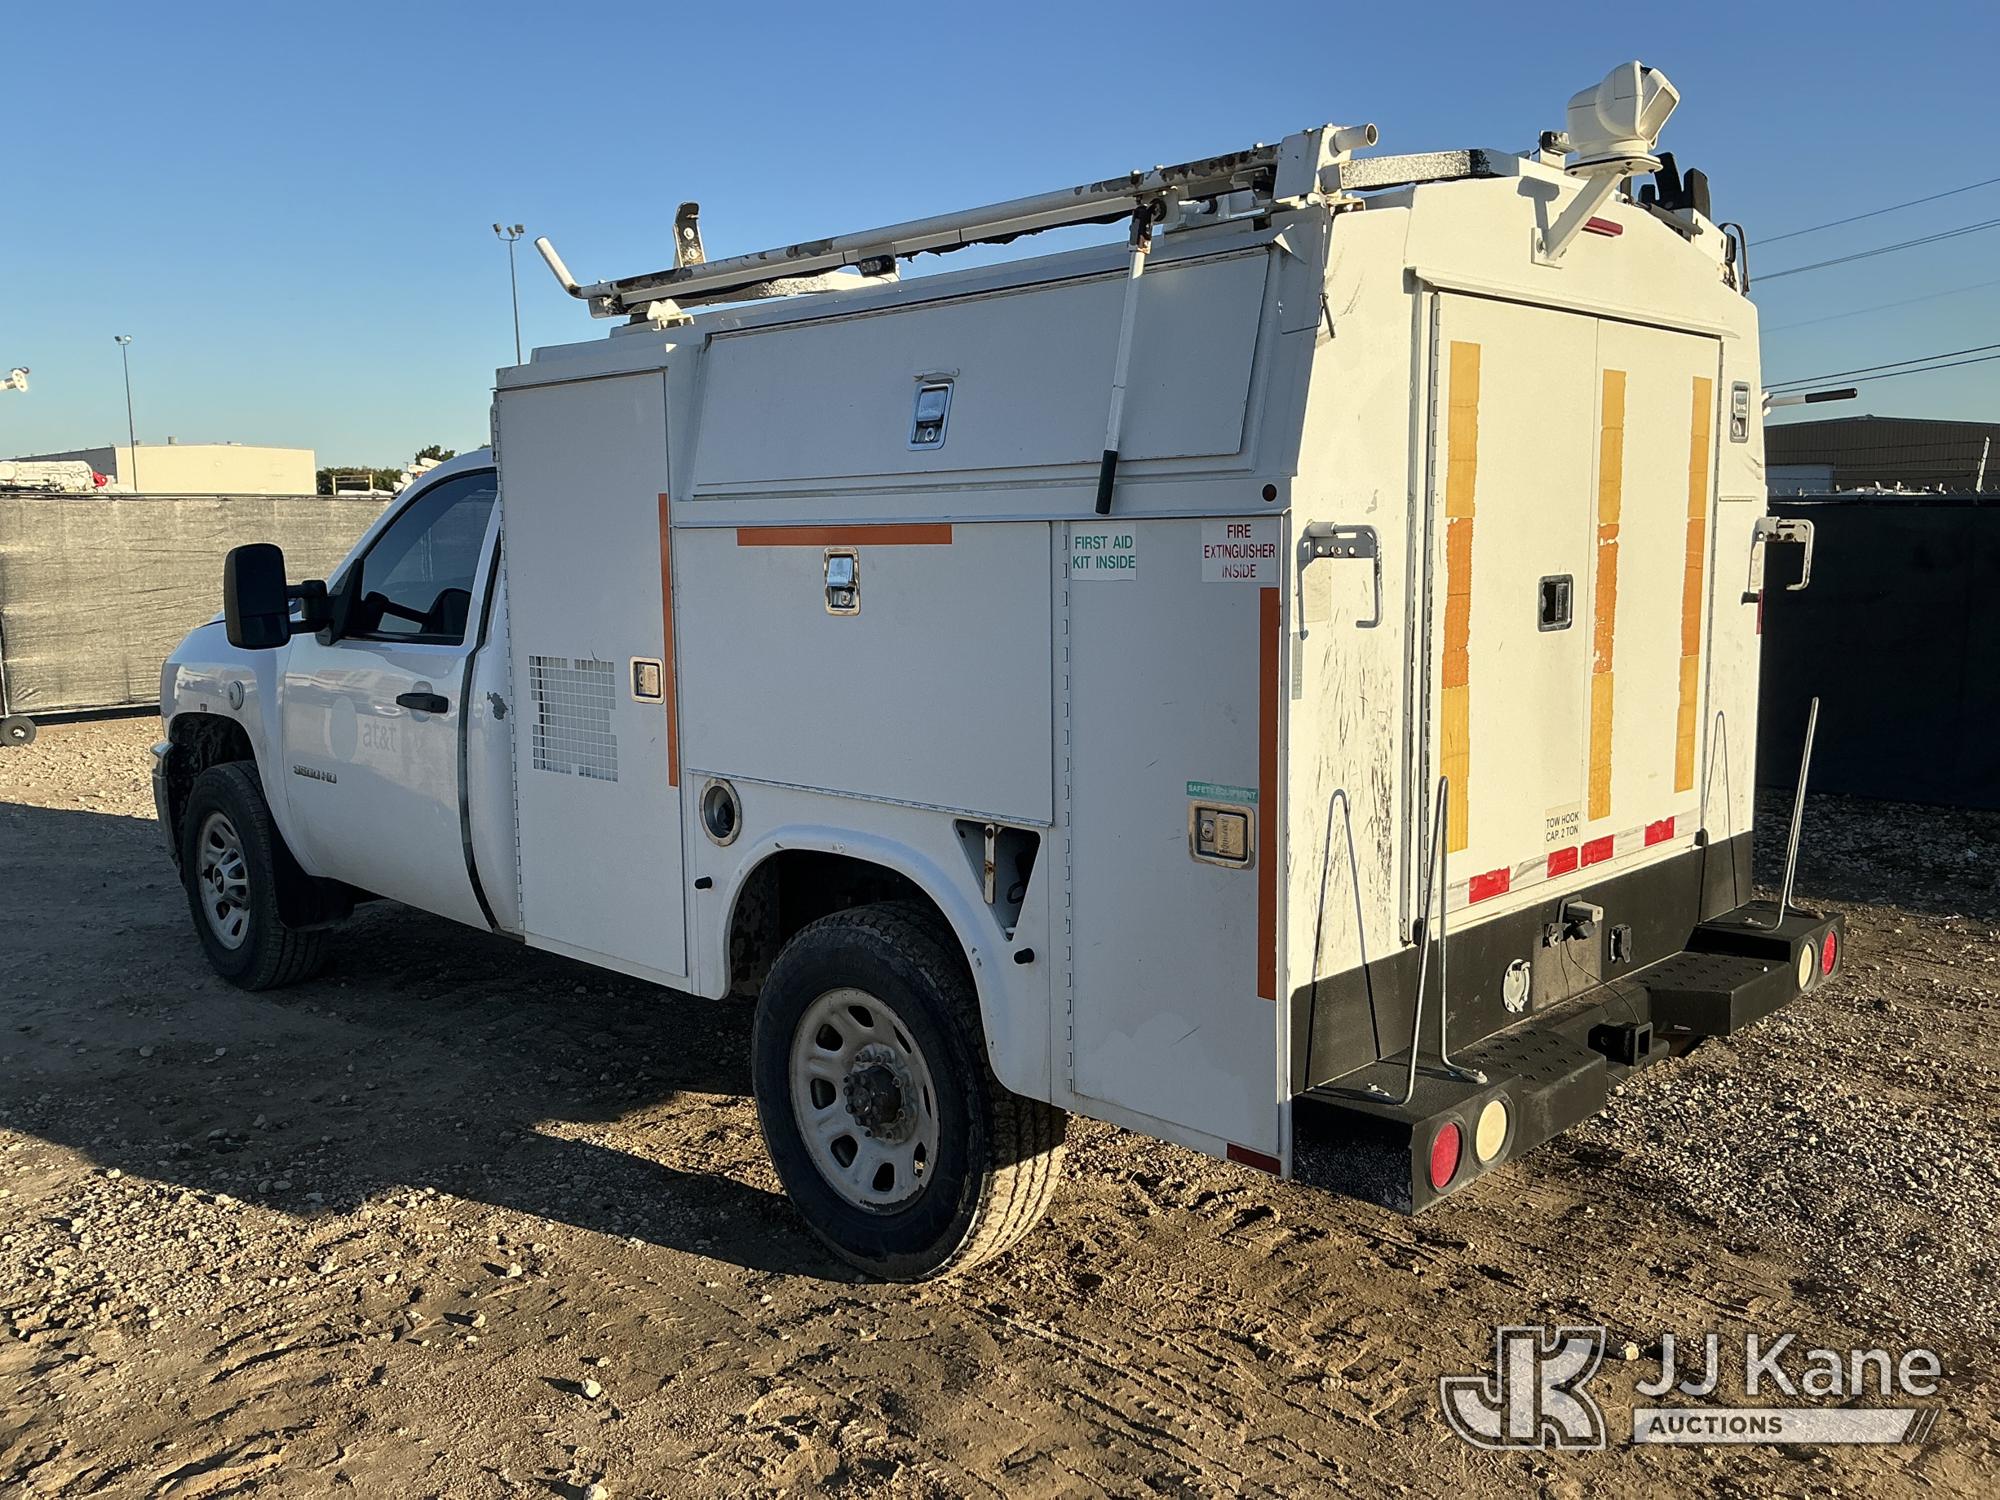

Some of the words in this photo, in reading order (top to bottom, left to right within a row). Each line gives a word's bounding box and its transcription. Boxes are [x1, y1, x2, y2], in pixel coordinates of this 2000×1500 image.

[1227, 524, 1251, 539] FIRE
[1074, 535, 1108, 549] FIRST
[1113, 535, 1133, 549] AID
[1204, 544, 1276, 559] EXTINGUISHER
[1072, 556, 1091, 569] KIT
[1096, 555, 1136, 569] INSIDE
[1222, 564, 1257, 578] INSIDE
[362, 720, 397, 752] at&t
[1546, 817, 1560, 829] TOW
[1561, 811, 1579, 825] HOOK
[1566, 824, 1579, 836] TON
